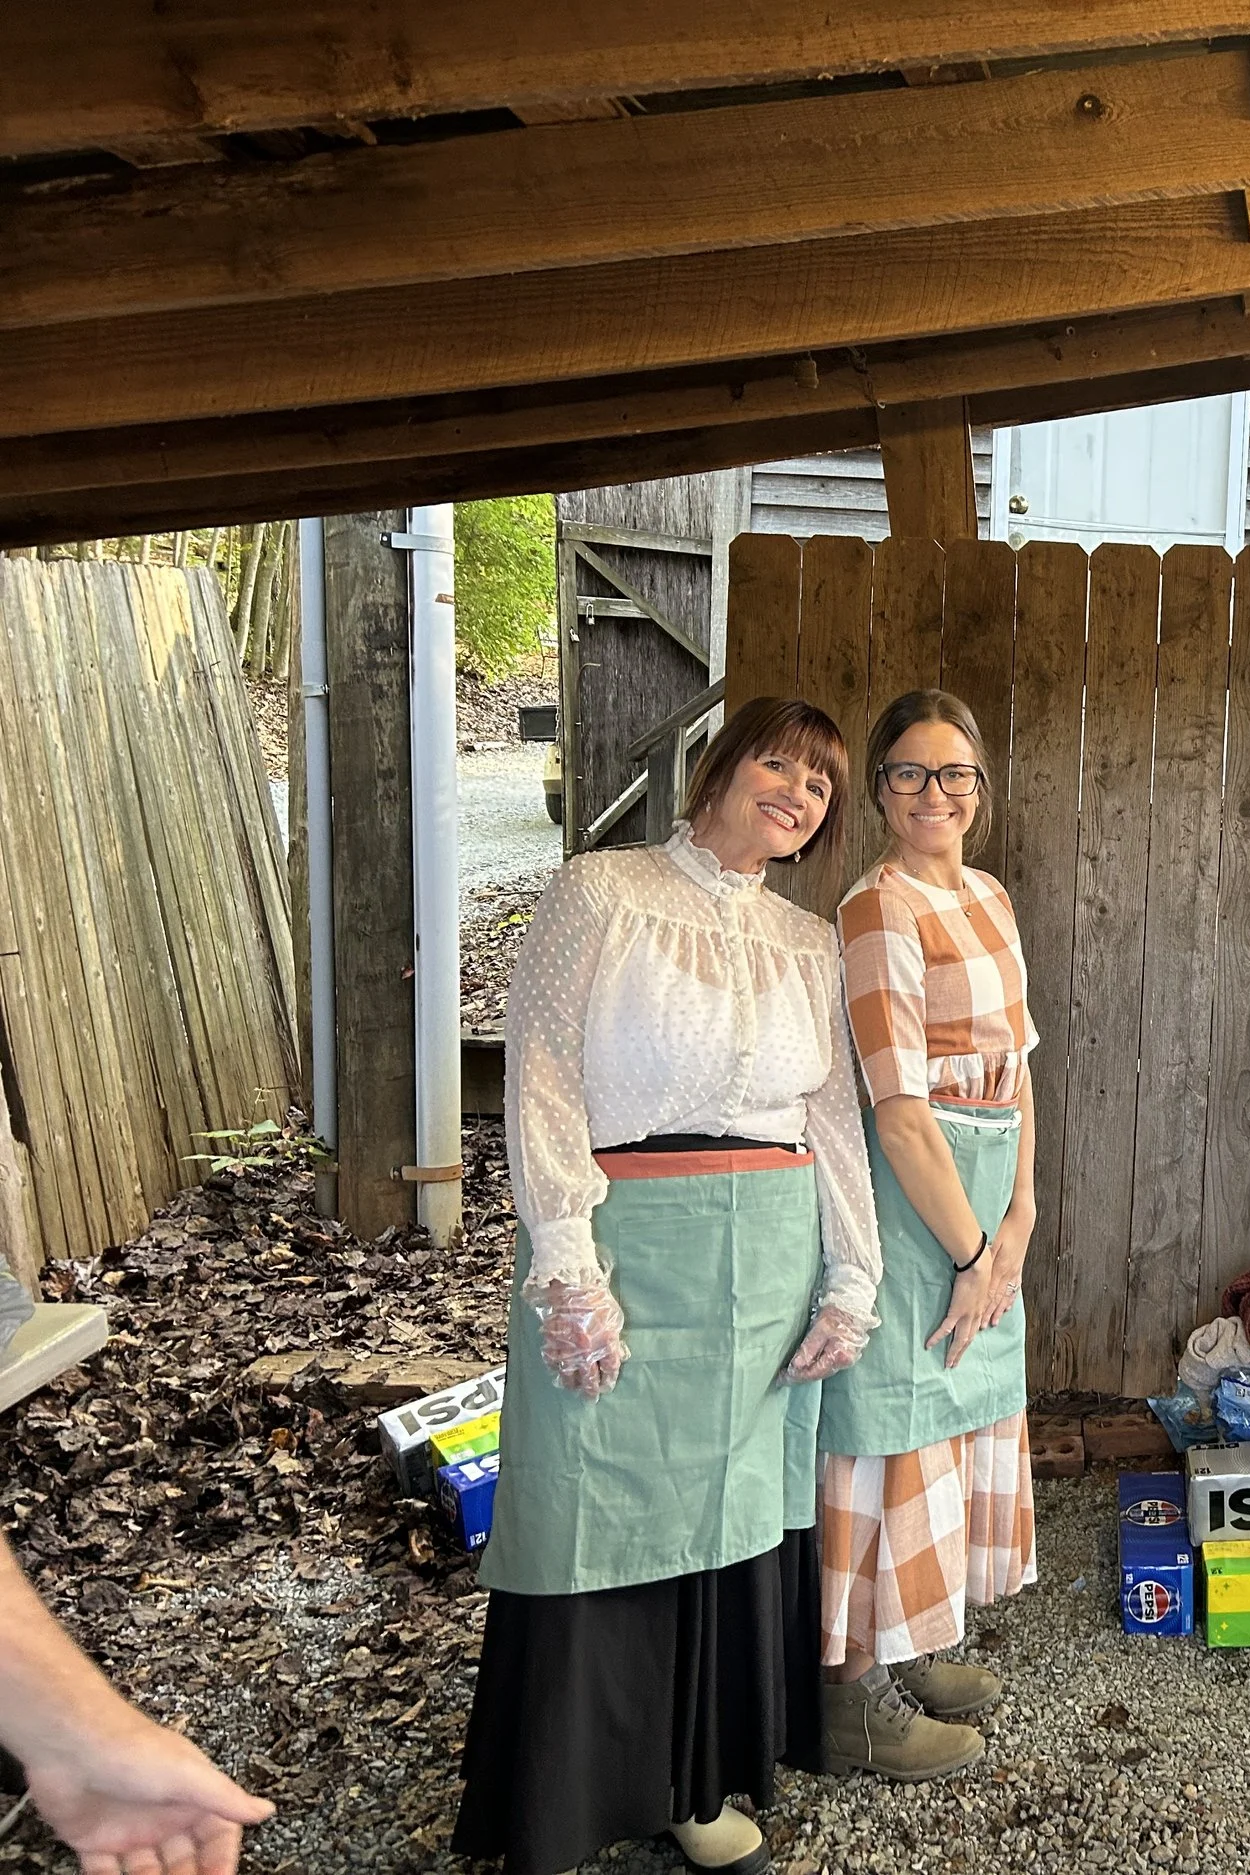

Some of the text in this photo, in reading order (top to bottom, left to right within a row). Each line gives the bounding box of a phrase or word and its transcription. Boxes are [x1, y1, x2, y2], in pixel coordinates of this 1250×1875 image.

[398, 1373, 506, 1436] PSI
[1147, 1501, 1160, 1524] PESI
[1144, 1583, 1155, 1620] PEPSI
